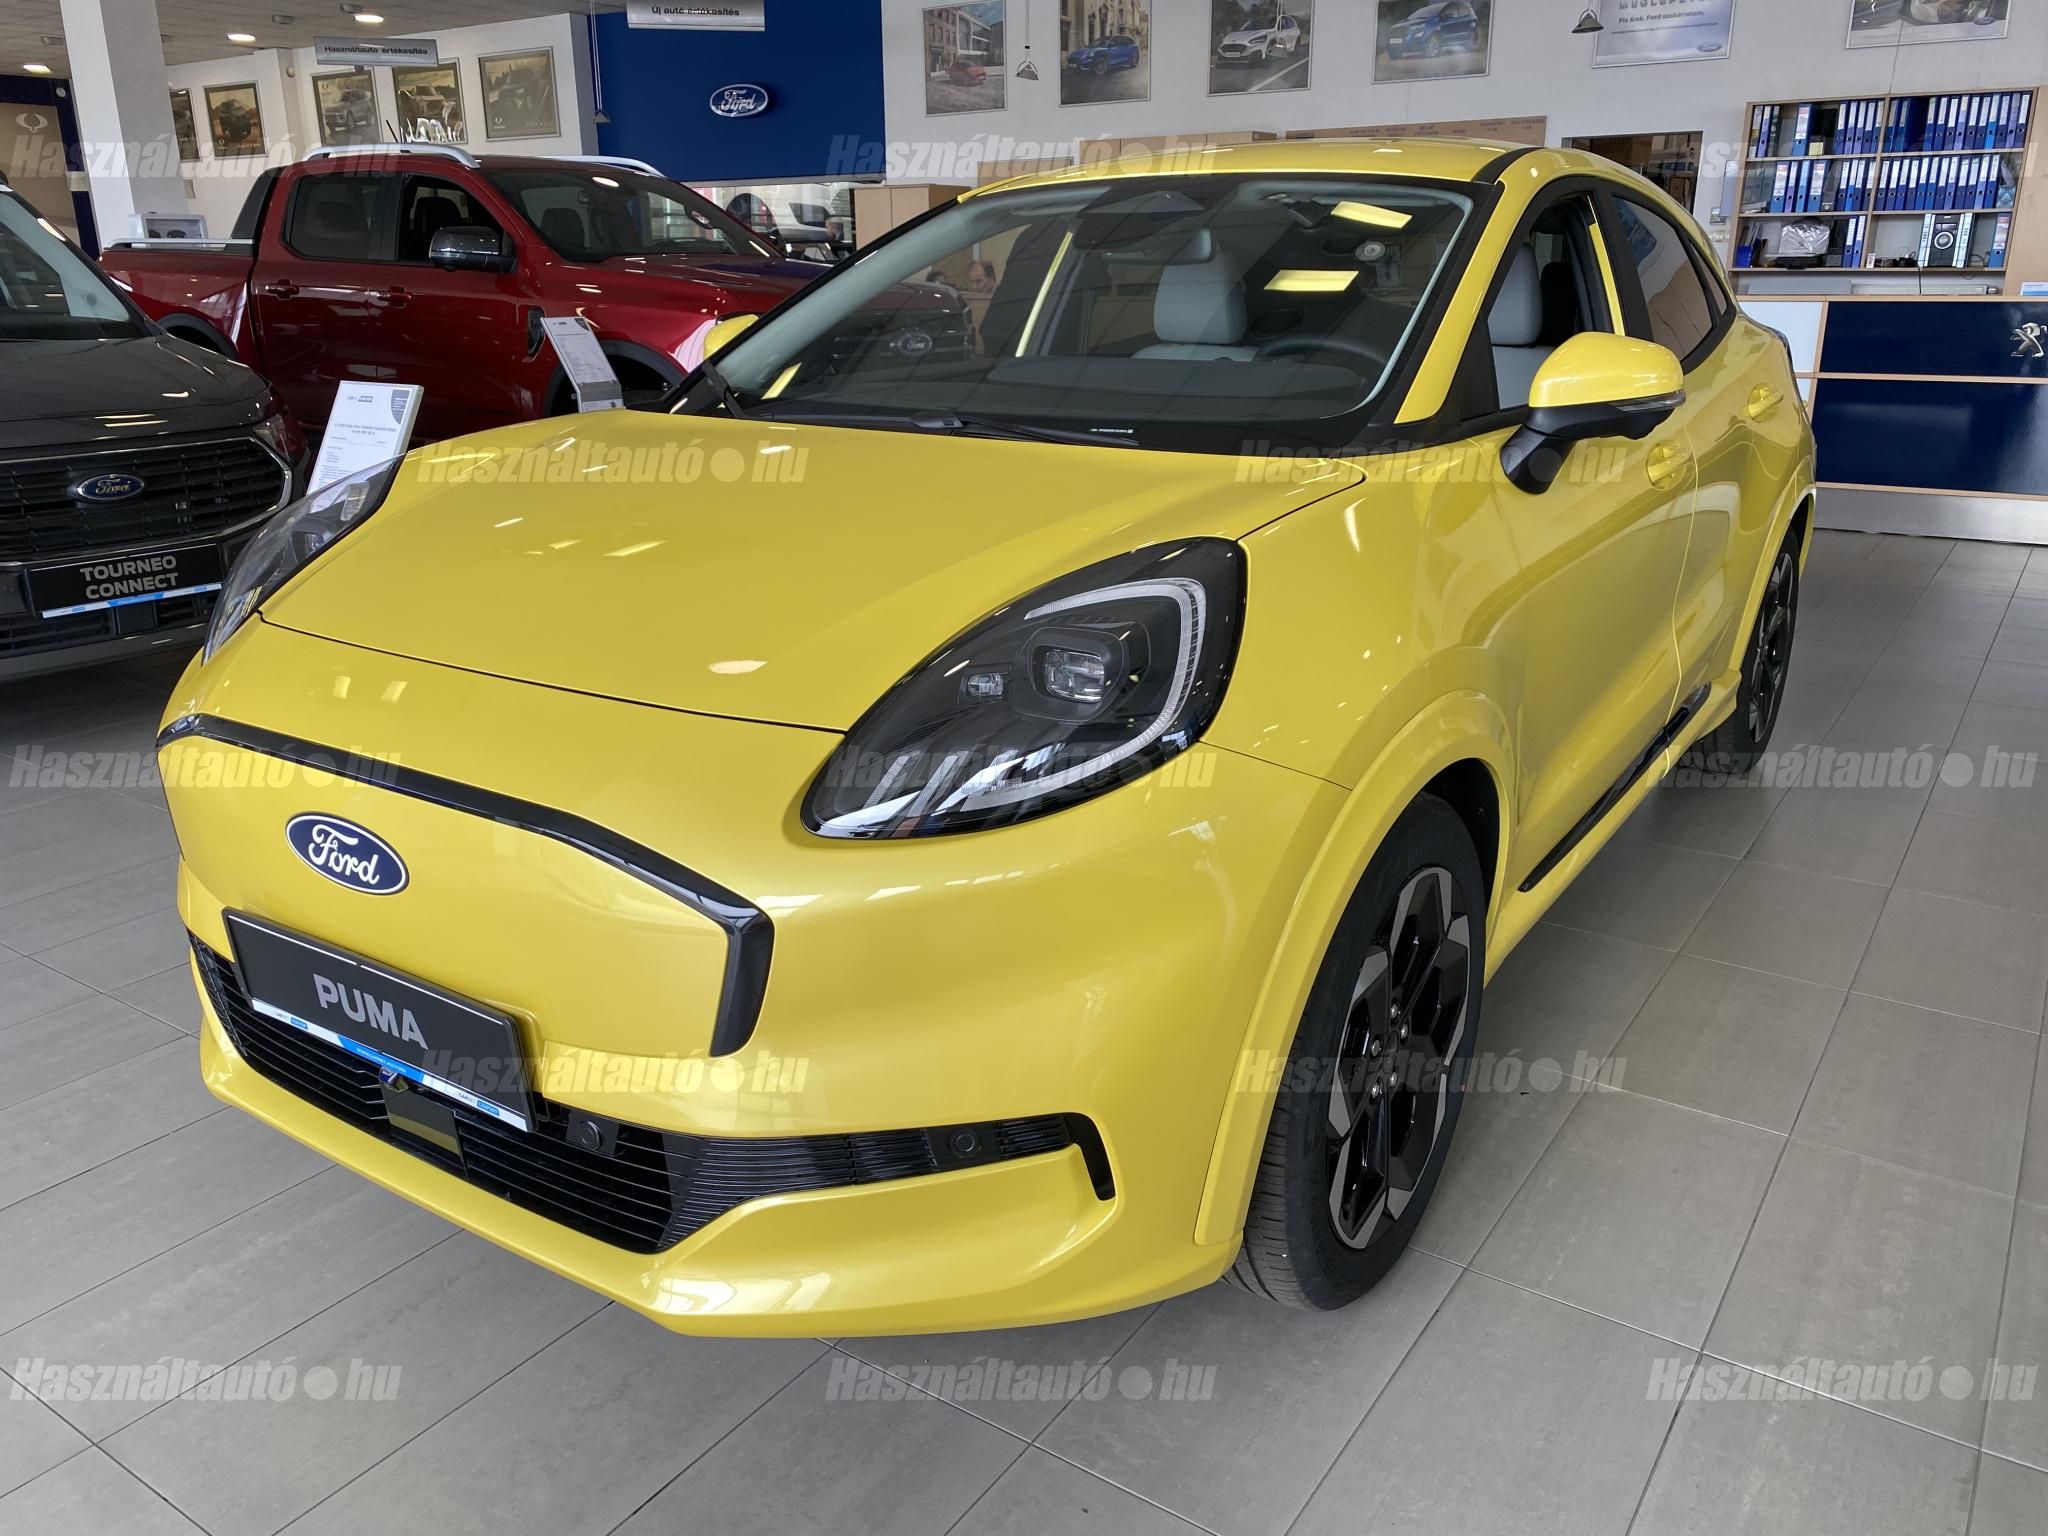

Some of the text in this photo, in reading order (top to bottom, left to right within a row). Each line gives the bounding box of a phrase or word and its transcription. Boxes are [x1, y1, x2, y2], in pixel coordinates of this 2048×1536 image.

[720, 89, 757, 111] Ford
[80, 556, 177, 582] TOURNEO
[85, 573, 179, 600] CONNECT
[308, 823, 381, 885] Ford
[312, 973, 429, 1050] PUMA
